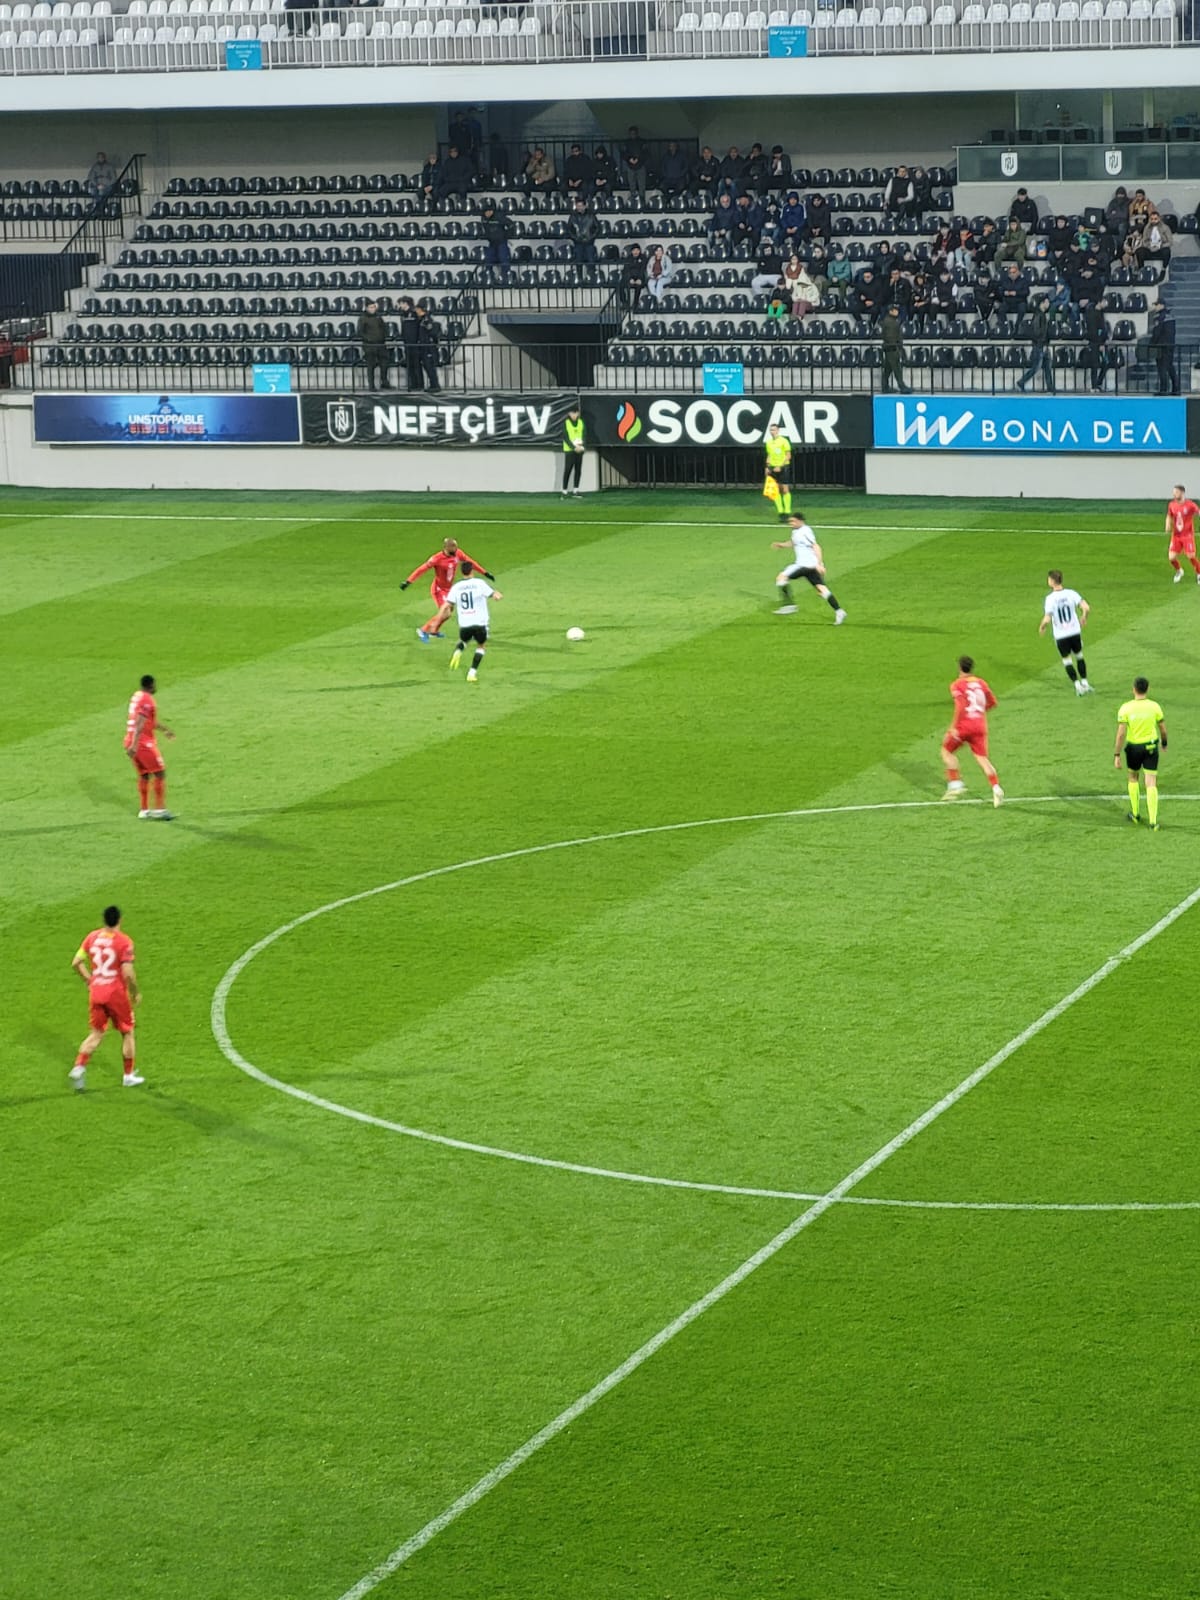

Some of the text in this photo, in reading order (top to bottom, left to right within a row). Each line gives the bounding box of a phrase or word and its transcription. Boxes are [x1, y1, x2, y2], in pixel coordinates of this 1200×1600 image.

[128, 414, 205, 425] UNSTOPPABLE
[373, 398, 552, 443] NEFTÇİ TV
[646, 399, 840, 444] SOCAR
[982, 420, 1163, 443] BONA DEA
[460, 591, 473, 610] 91
[1058, 605, 1071, 624] 10
[89, 946, 118, 977] 32
